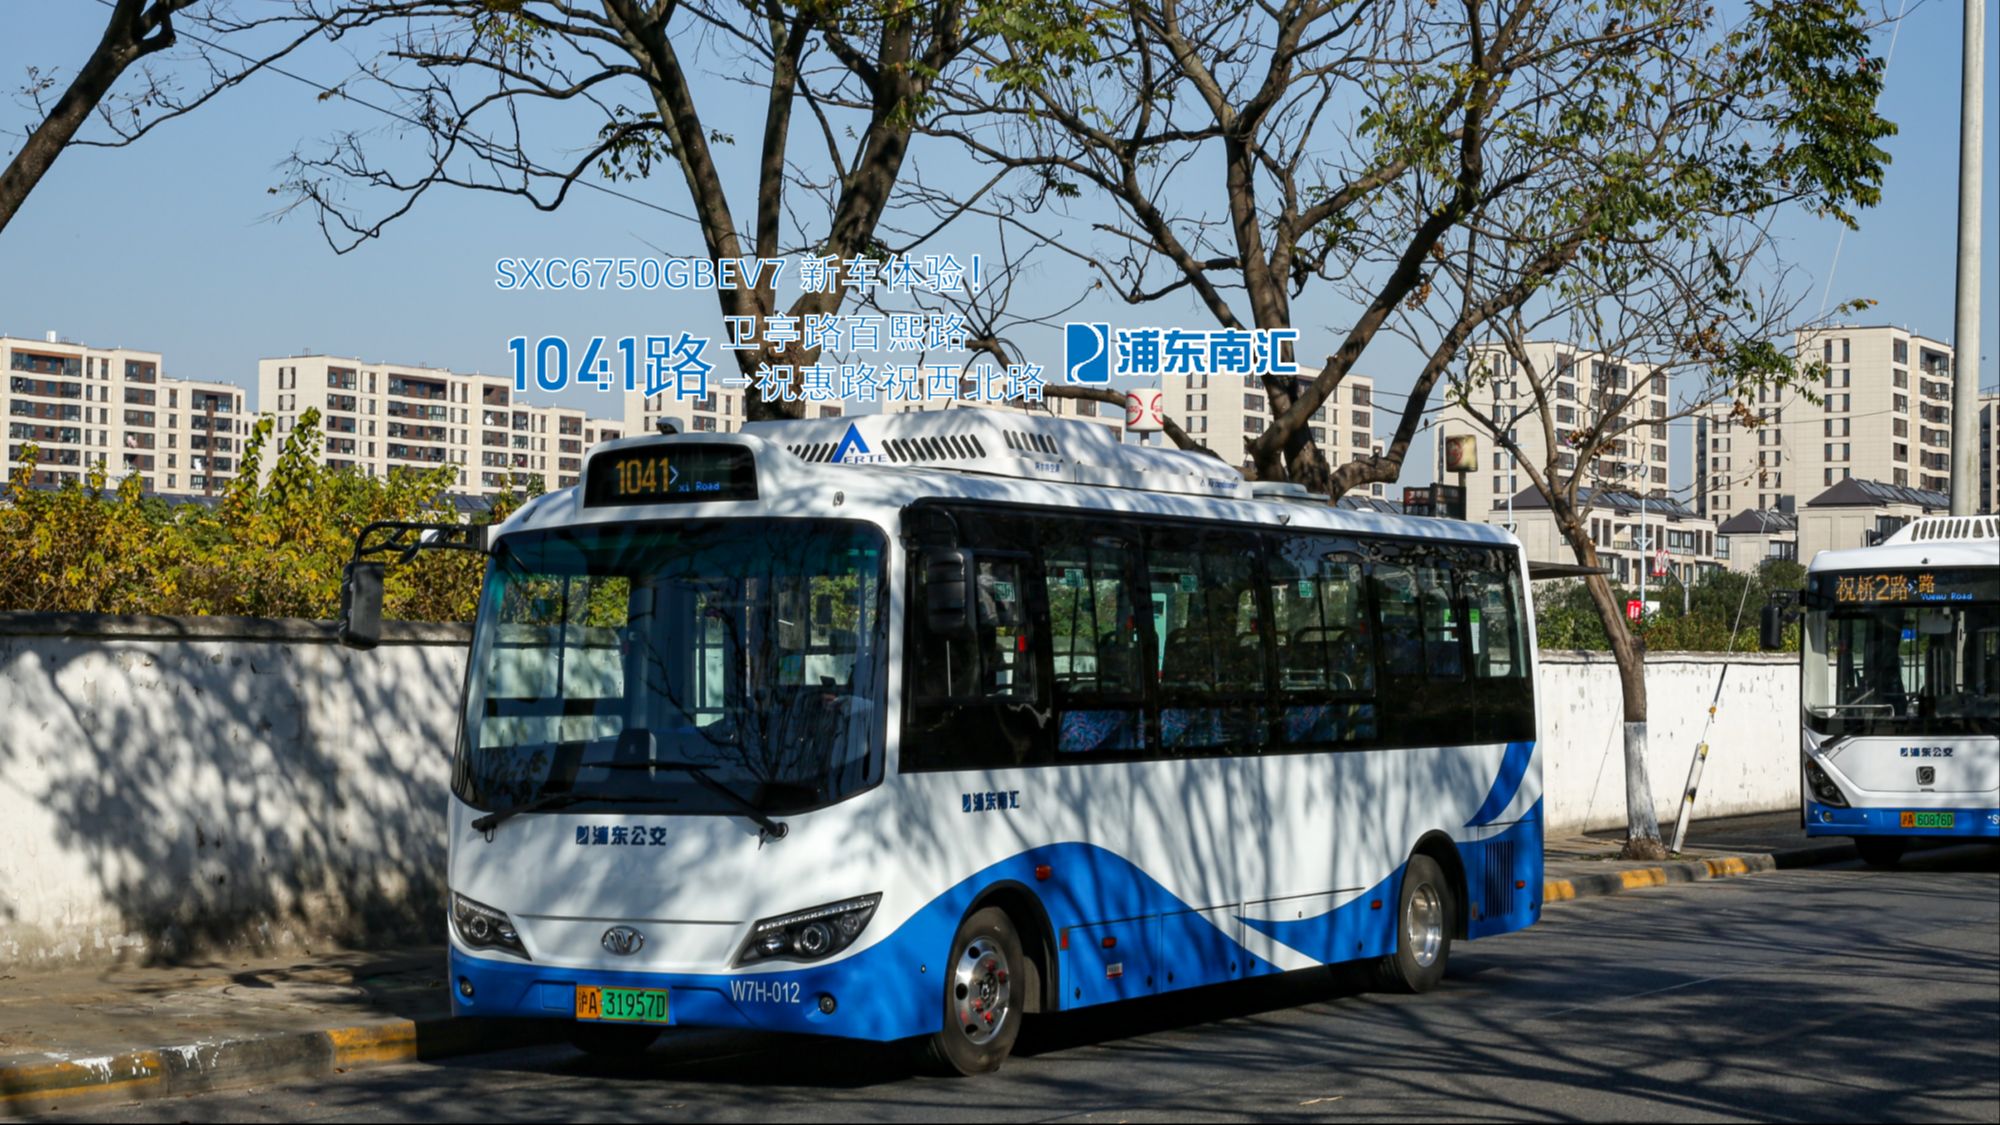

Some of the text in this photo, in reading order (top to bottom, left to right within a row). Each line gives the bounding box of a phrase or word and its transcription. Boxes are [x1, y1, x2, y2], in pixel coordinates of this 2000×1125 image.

[615, 457, 670, 495] 1041
[695, 481, 721, 491] Road
[1836, 574, 1909, 602] 祝桥2路
[1951, 592, 1973, 600] Road
[730, 980, 801, 1004] W7H-012
